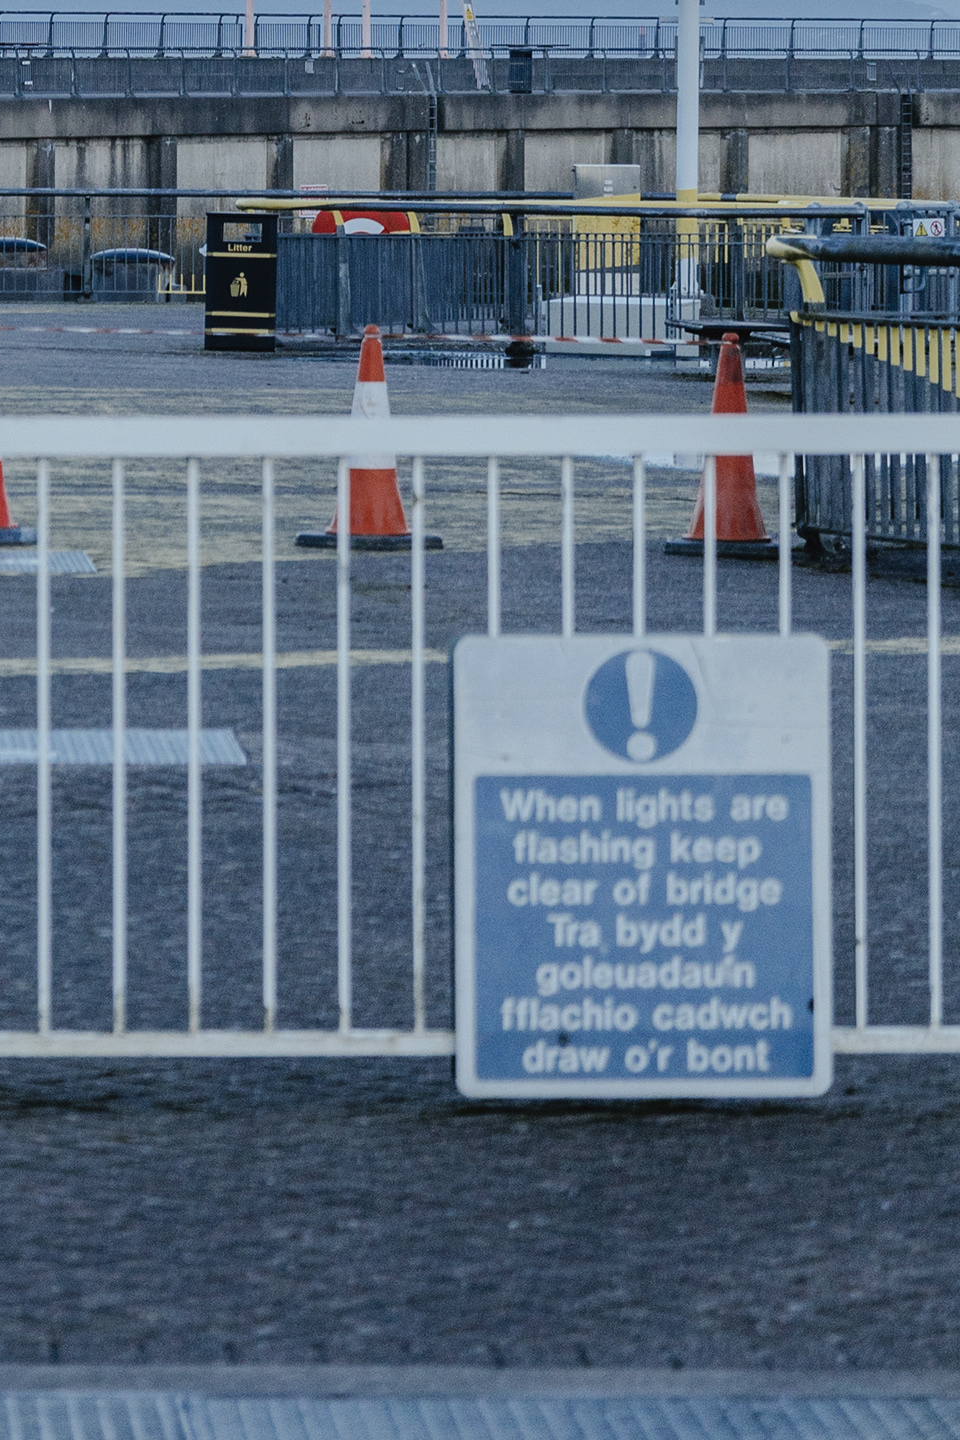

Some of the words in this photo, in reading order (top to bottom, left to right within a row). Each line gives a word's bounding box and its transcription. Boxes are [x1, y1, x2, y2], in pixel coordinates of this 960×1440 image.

[227, 243, 253, 252] Litter
[500, 788, 602, 822] When
[616, 788, 715, 828] lights
[731, 795, 788, 822] are
[512, 830, 656, 870] flashing
[670, 830, 762, 869] keep
[507, 872, 598, 906] clear
[613, 872, 650, 906] of
[666, 872, 783, 912] bridge
[547, 913, 601, 948] Tra
[616, 913, 706, 954] bydd
[721, 921, 744, 953] y
[535, 956, 756, 996] goleuadau'n
[501, 997, 639, 1032] fflachio
[652, 997, 792, 1032] cadwch
[522, 1040, 610, 1074] draw
[624, 1039, 674, 1074] o'r
[687, 1040, 770, 1074] bont
